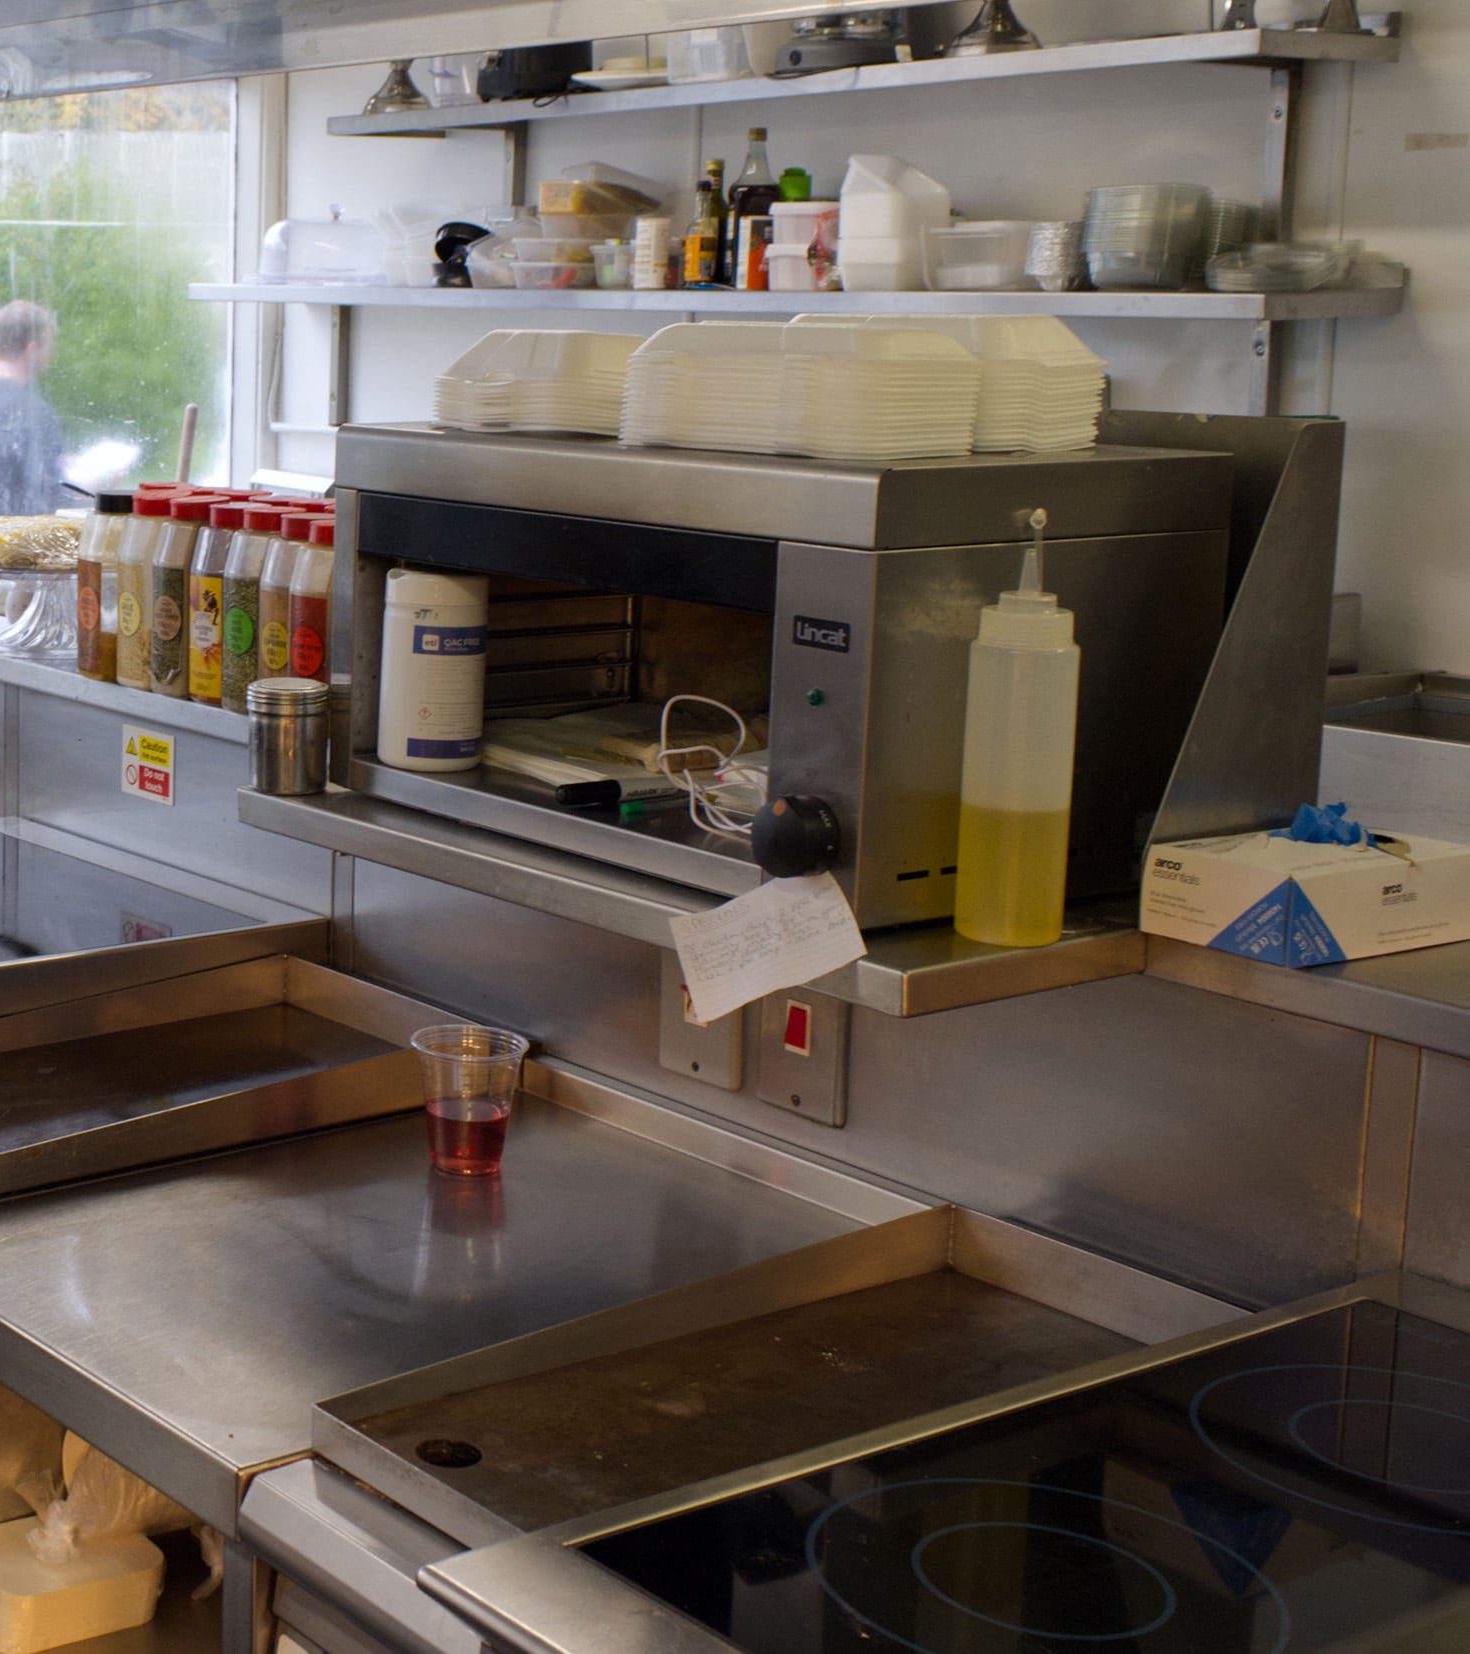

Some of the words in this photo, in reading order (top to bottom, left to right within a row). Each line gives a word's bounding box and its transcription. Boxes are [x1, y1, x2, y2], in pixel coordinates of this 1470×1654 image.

[796, 621, 848, 648] Lincat
[141, 738, 168, 754] Caution
[143, 767, 154, 779] Do
[154, 773, 165, 782] not
[145, 780, 164, 793] touch
[1154, 858, 1182, 871] arco
[1152, 868, 1202, 887] essentials
[1382, 884, 1403, 896] arco
